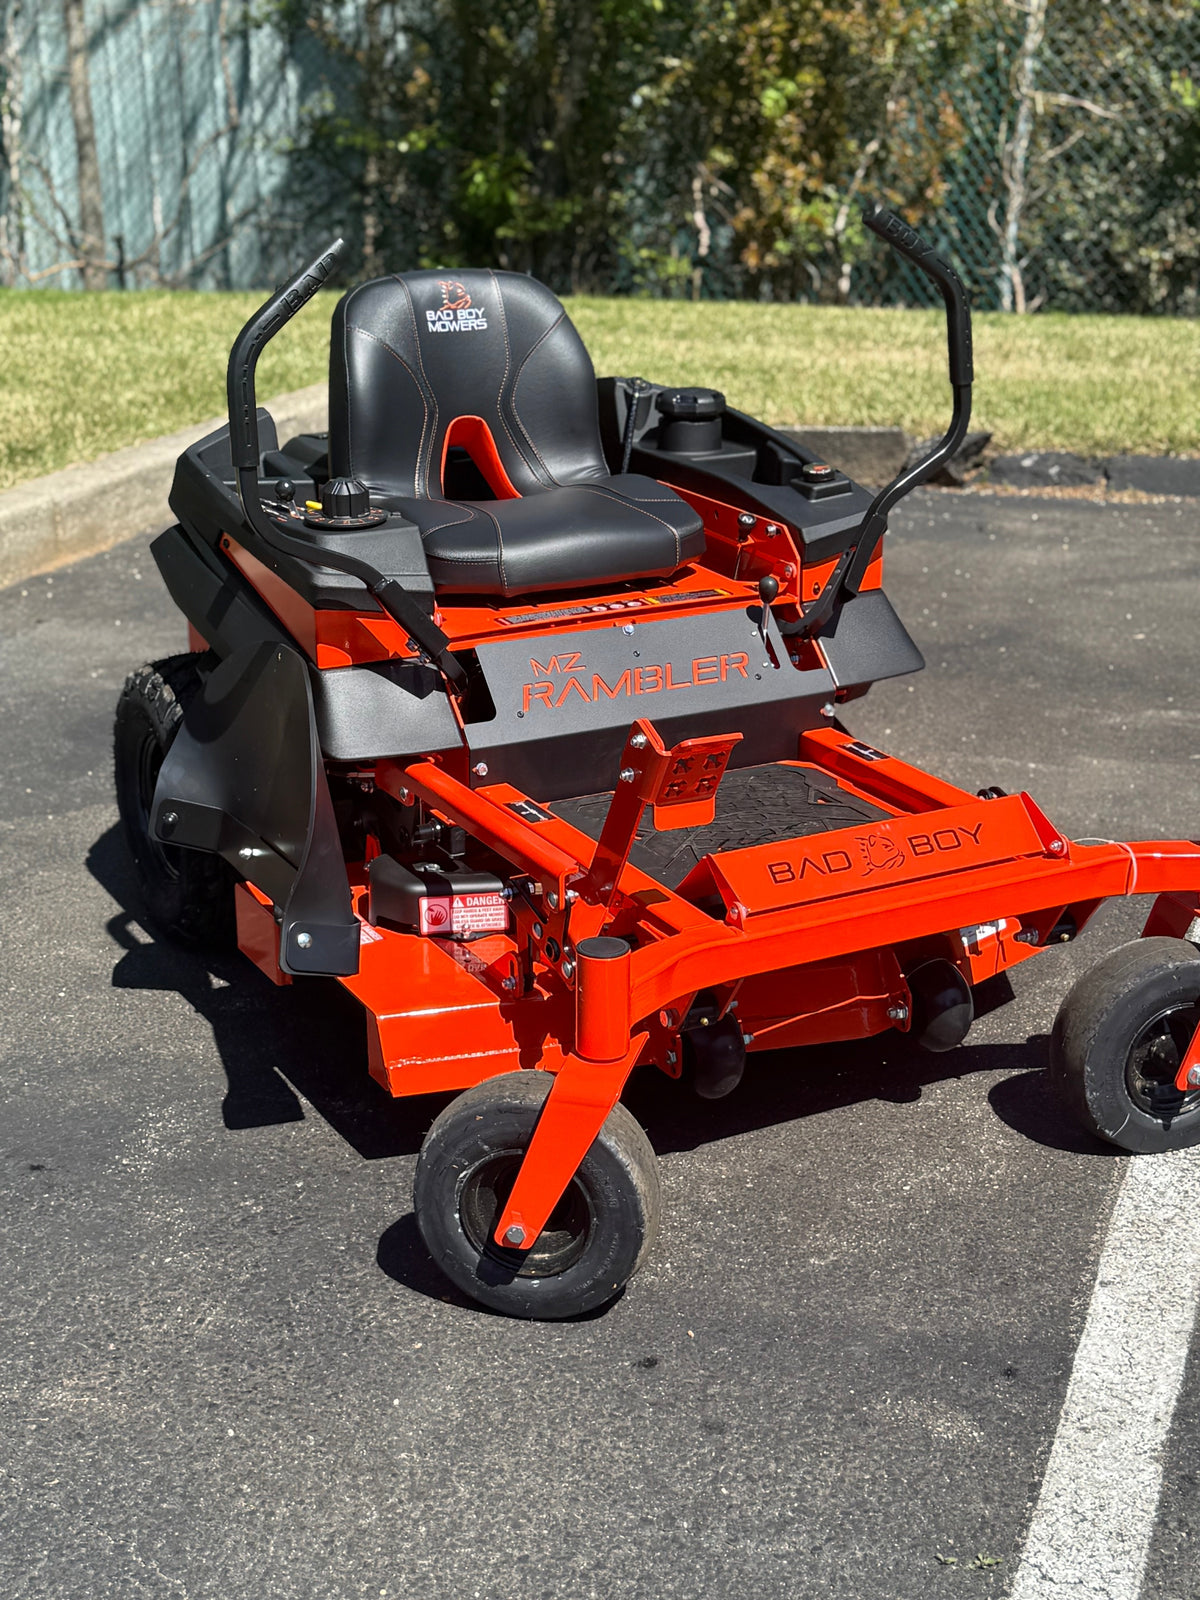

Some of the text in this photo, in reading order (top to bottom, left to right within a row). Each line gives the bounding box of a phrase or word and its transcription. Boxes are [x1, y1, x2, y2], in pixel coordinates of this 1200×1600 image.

[425, 307, 485, 321] BAD BOY
[427, 318, 488, 332] MOWERS
[529, 651, 587, 677] MZ
[522, 651, 749, 713] RAMBLER
[767, 823, 982, 884] BAD BOY
[466, 895, 505, 907] DANGER
